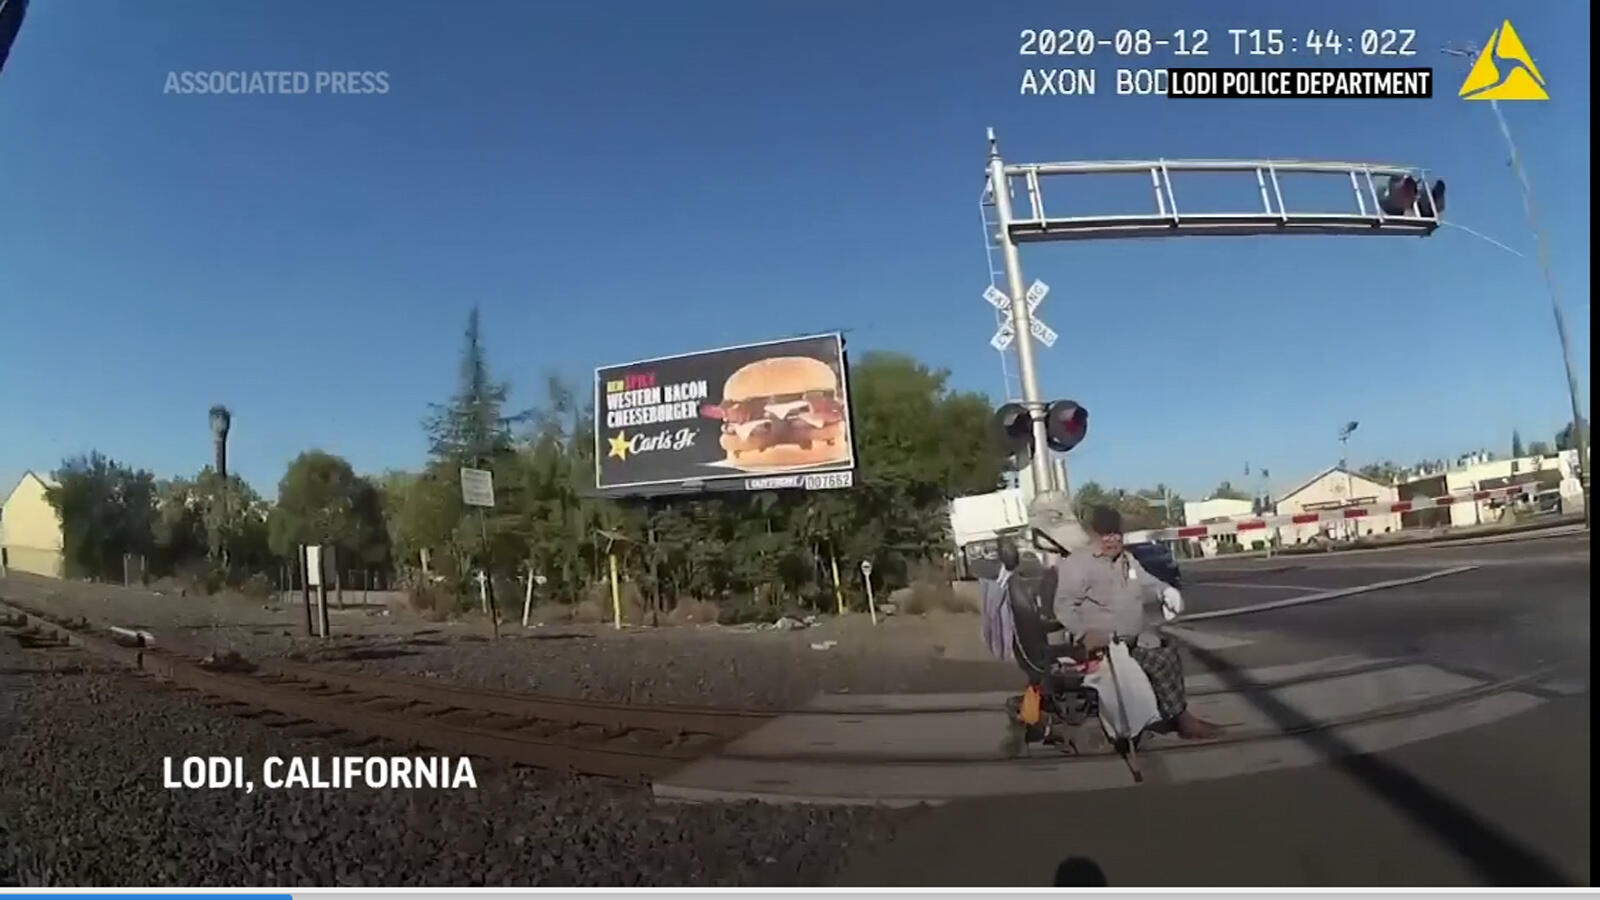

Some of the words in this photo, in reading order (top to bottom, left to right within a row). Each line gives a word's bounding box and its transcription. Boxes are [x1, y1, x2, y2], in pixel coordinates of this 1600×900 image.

[607, 386, 661, 411] WESTERN
[664, 380, 708, 402] BACON
[607, 401, 698, 428] CHEESEBURGER
[629, 429, 673, 454] Carl's
